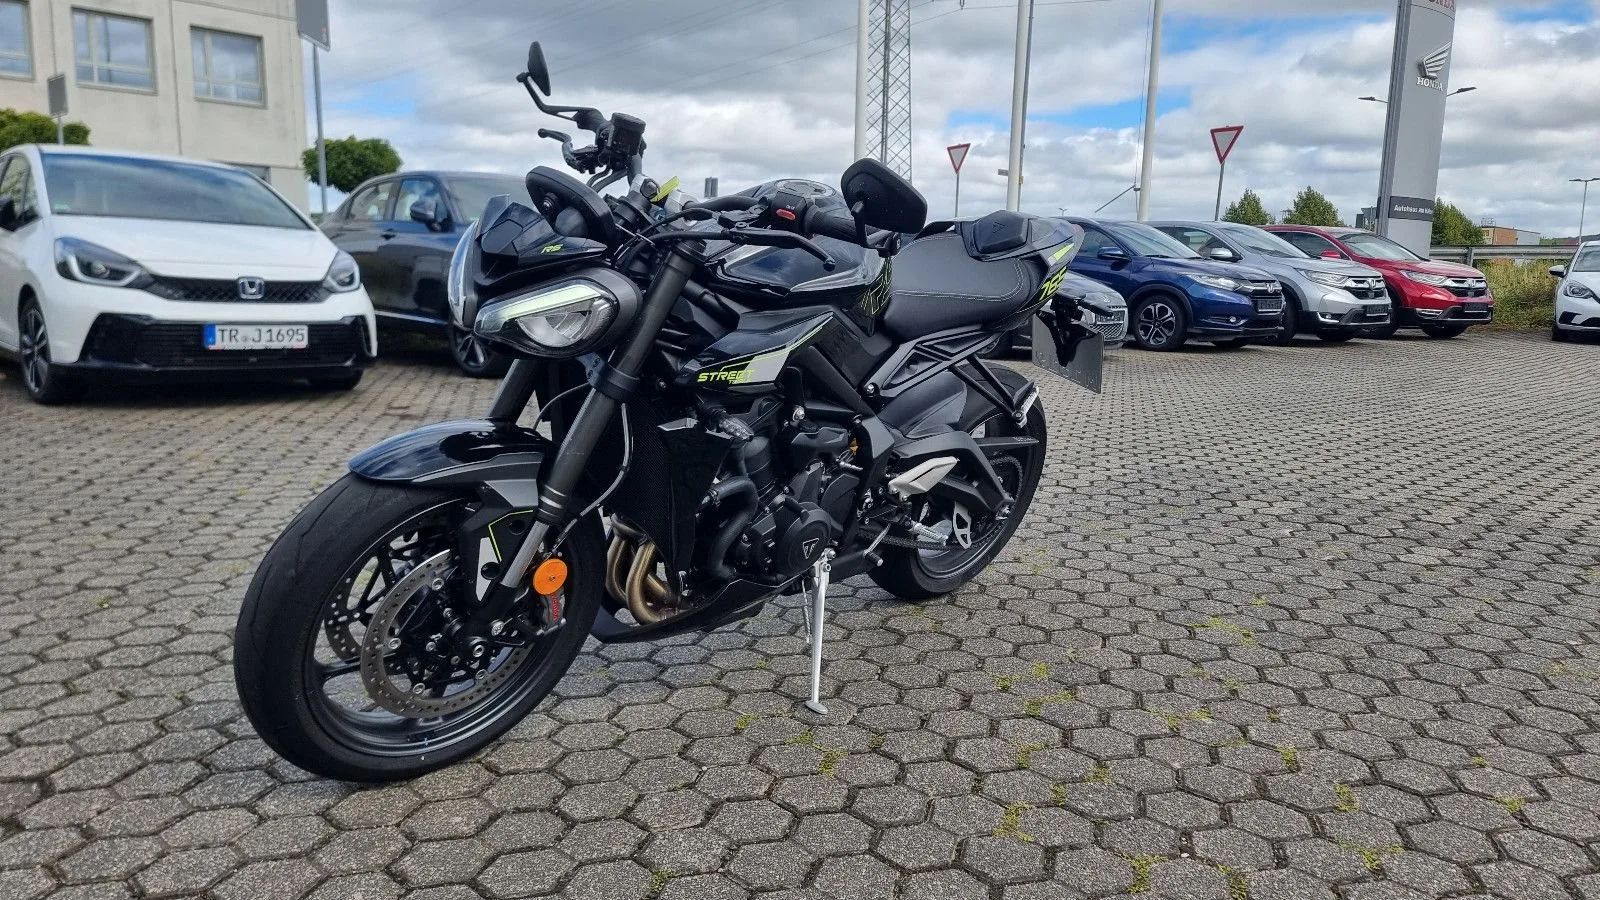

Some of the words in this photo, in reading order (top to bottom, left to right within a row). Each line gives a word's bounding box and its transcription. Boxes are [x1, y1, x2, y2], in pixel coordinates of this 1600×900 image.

[1416, 76, 1443, 91] HONDA
[541, 244, 563, 254] RS
[218, 328, 240, 342] TR
[696, 369, 755, 382] STREET
